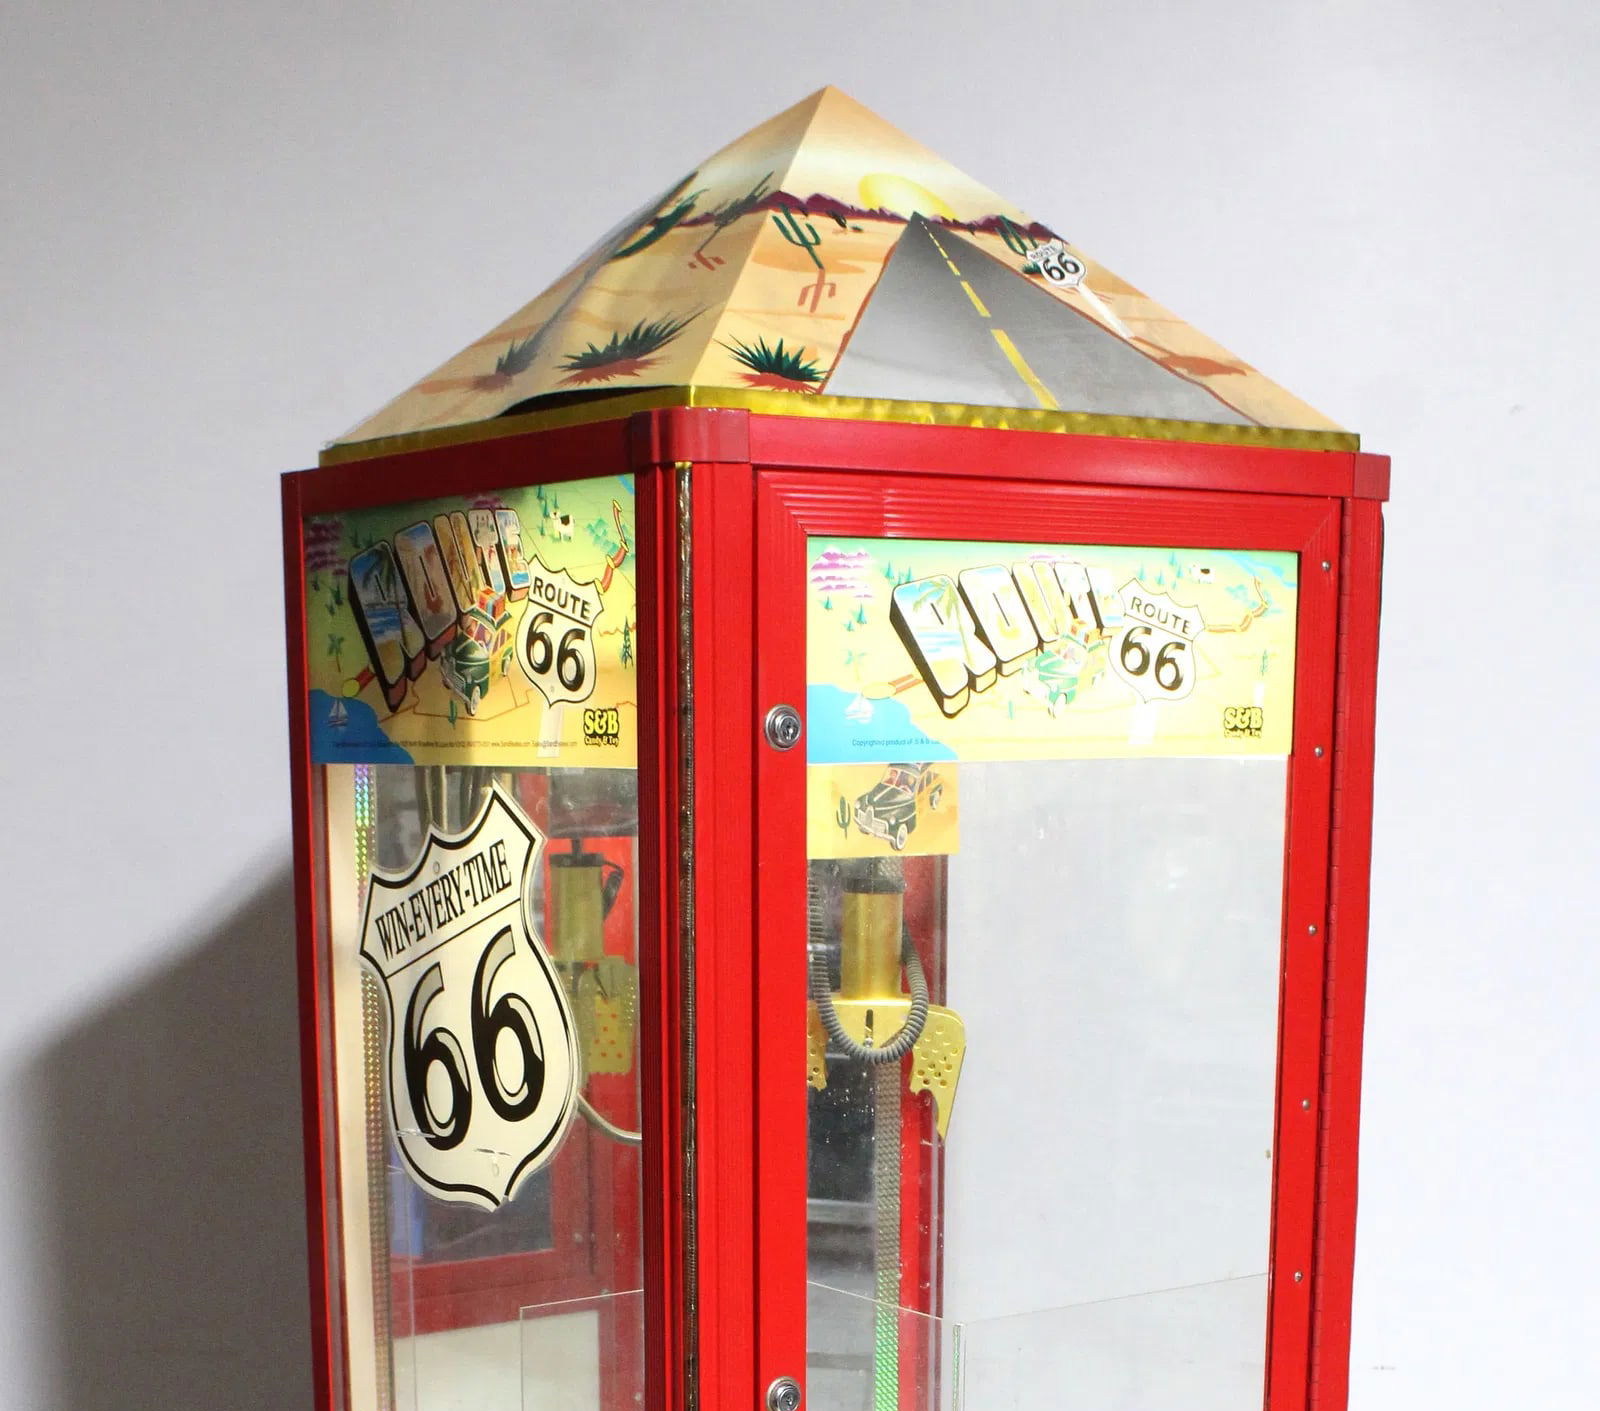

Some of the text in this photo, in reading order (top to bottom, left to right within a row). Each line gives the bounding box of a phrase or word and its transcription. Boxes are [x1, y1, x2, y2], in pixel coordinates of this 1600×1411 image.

[1043, 252, 1080, 281] 66
[532, 577, 592, 622] ROUTE
[1131, 596, 1190, 635] ROUTE
[525, 611, 587, 692] 66
[1121, 626, 1186, 691] 66
[375, 838, 512, 962] WIN-EVERY-TIME
[404, 924, 546, 1151] 66
